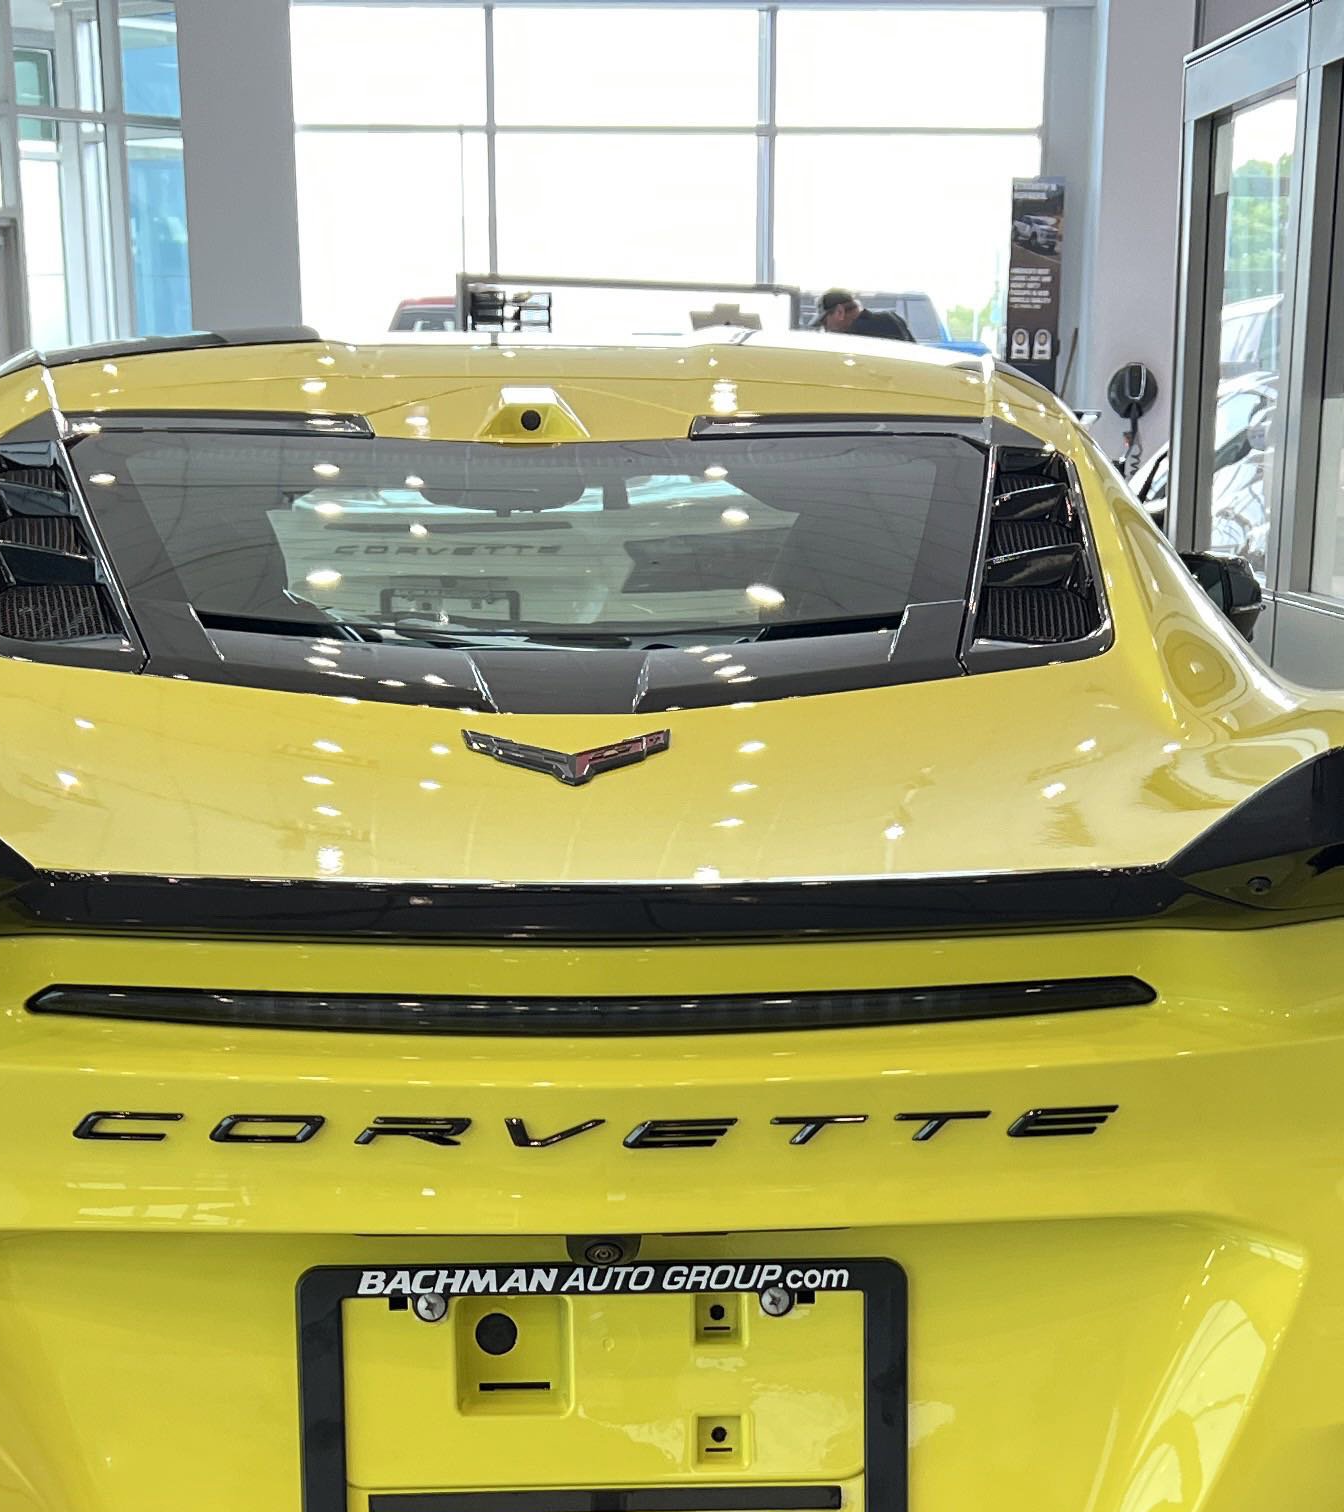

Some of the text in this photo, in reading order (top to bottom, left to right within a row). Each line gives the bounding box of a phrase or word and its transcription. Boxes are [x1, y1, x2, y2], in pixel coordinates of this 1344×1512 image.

[72, 1104, 1119, 1149] CORVETTE
[357, 1268, 558, 1295] BACHMAN
[560, 1266, 656, 1292] AUTO
